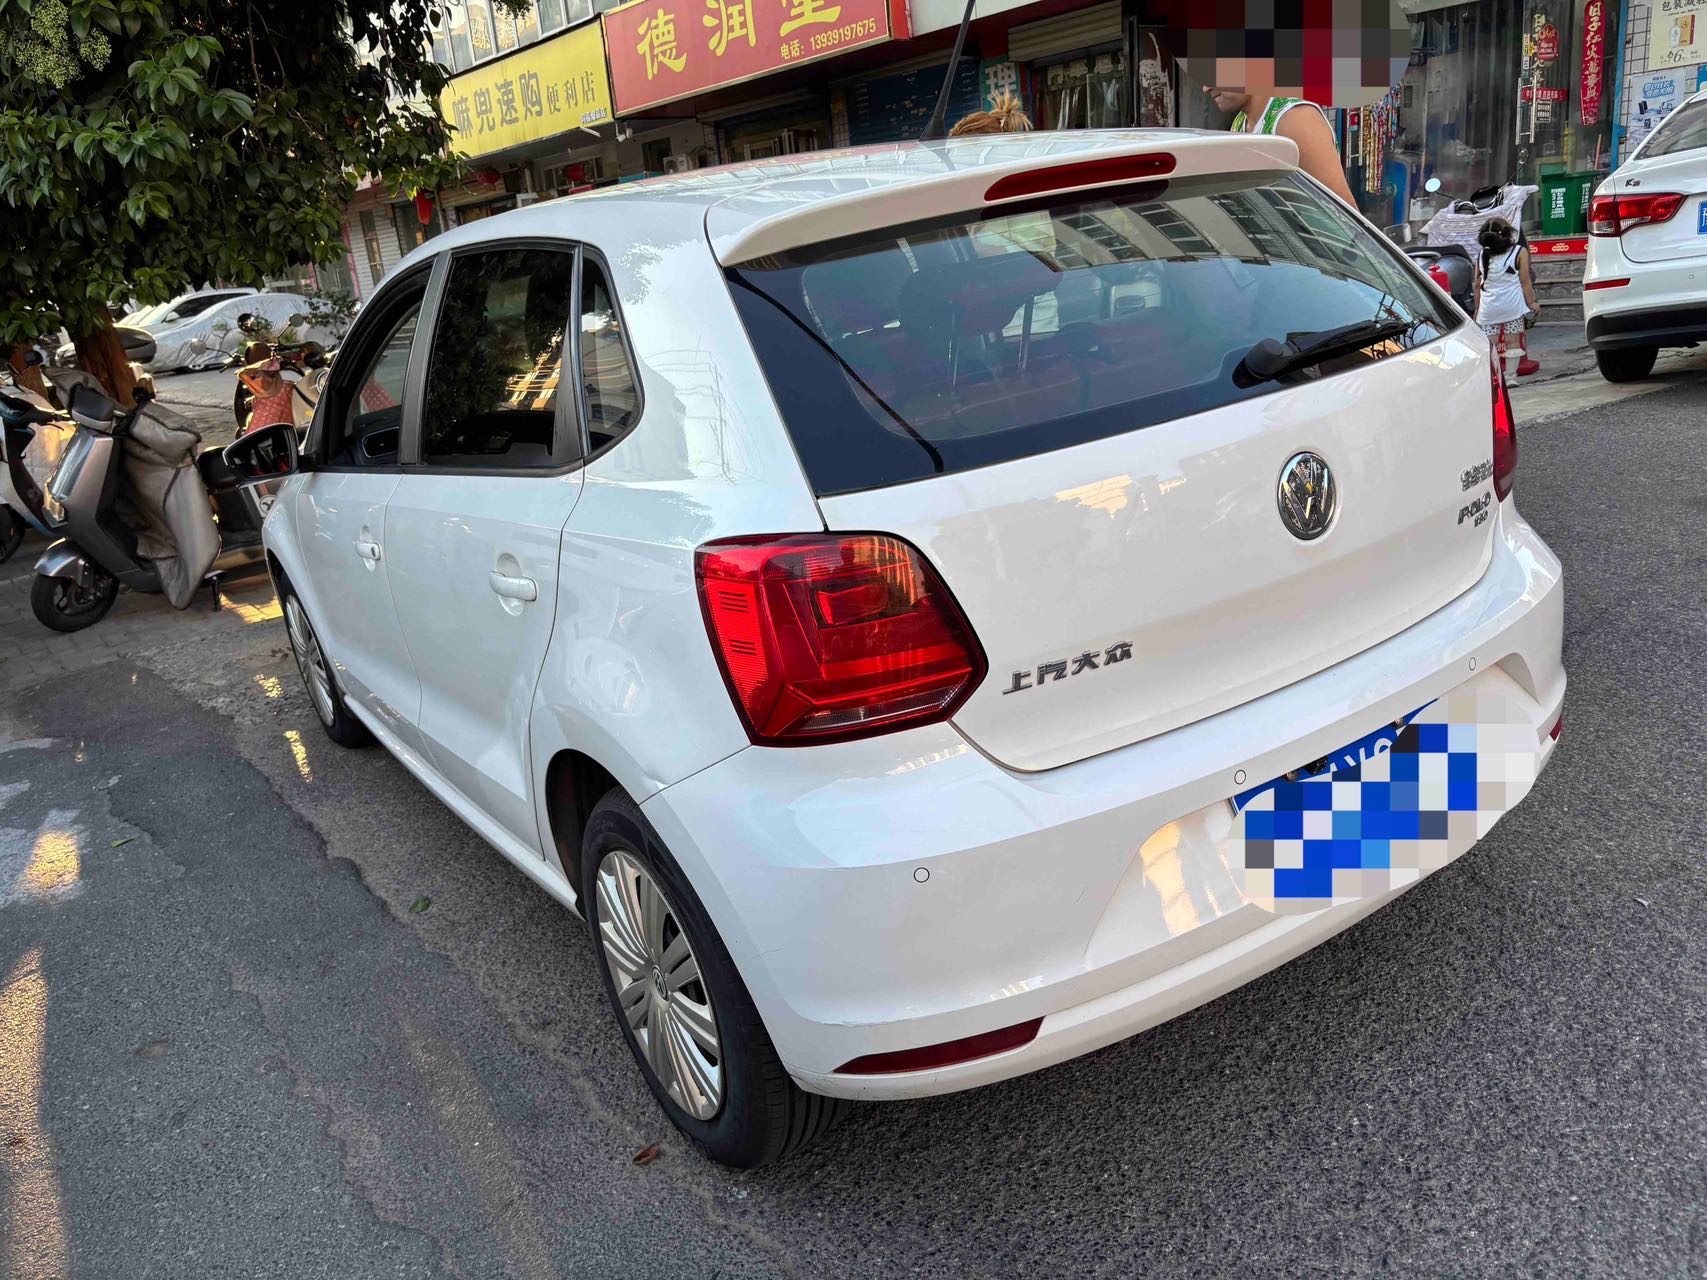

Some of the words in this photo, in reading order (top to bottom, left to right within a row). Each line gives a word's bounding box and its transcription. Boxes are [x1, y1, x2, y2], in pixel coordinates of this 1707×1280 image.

[810, 18, 876, 51] 13939197675
[546, 71, 595, 114] 便利店
[1458, 491, 1491, 525] POLO
[1002, 640, 1133, 695] 上汽大众
